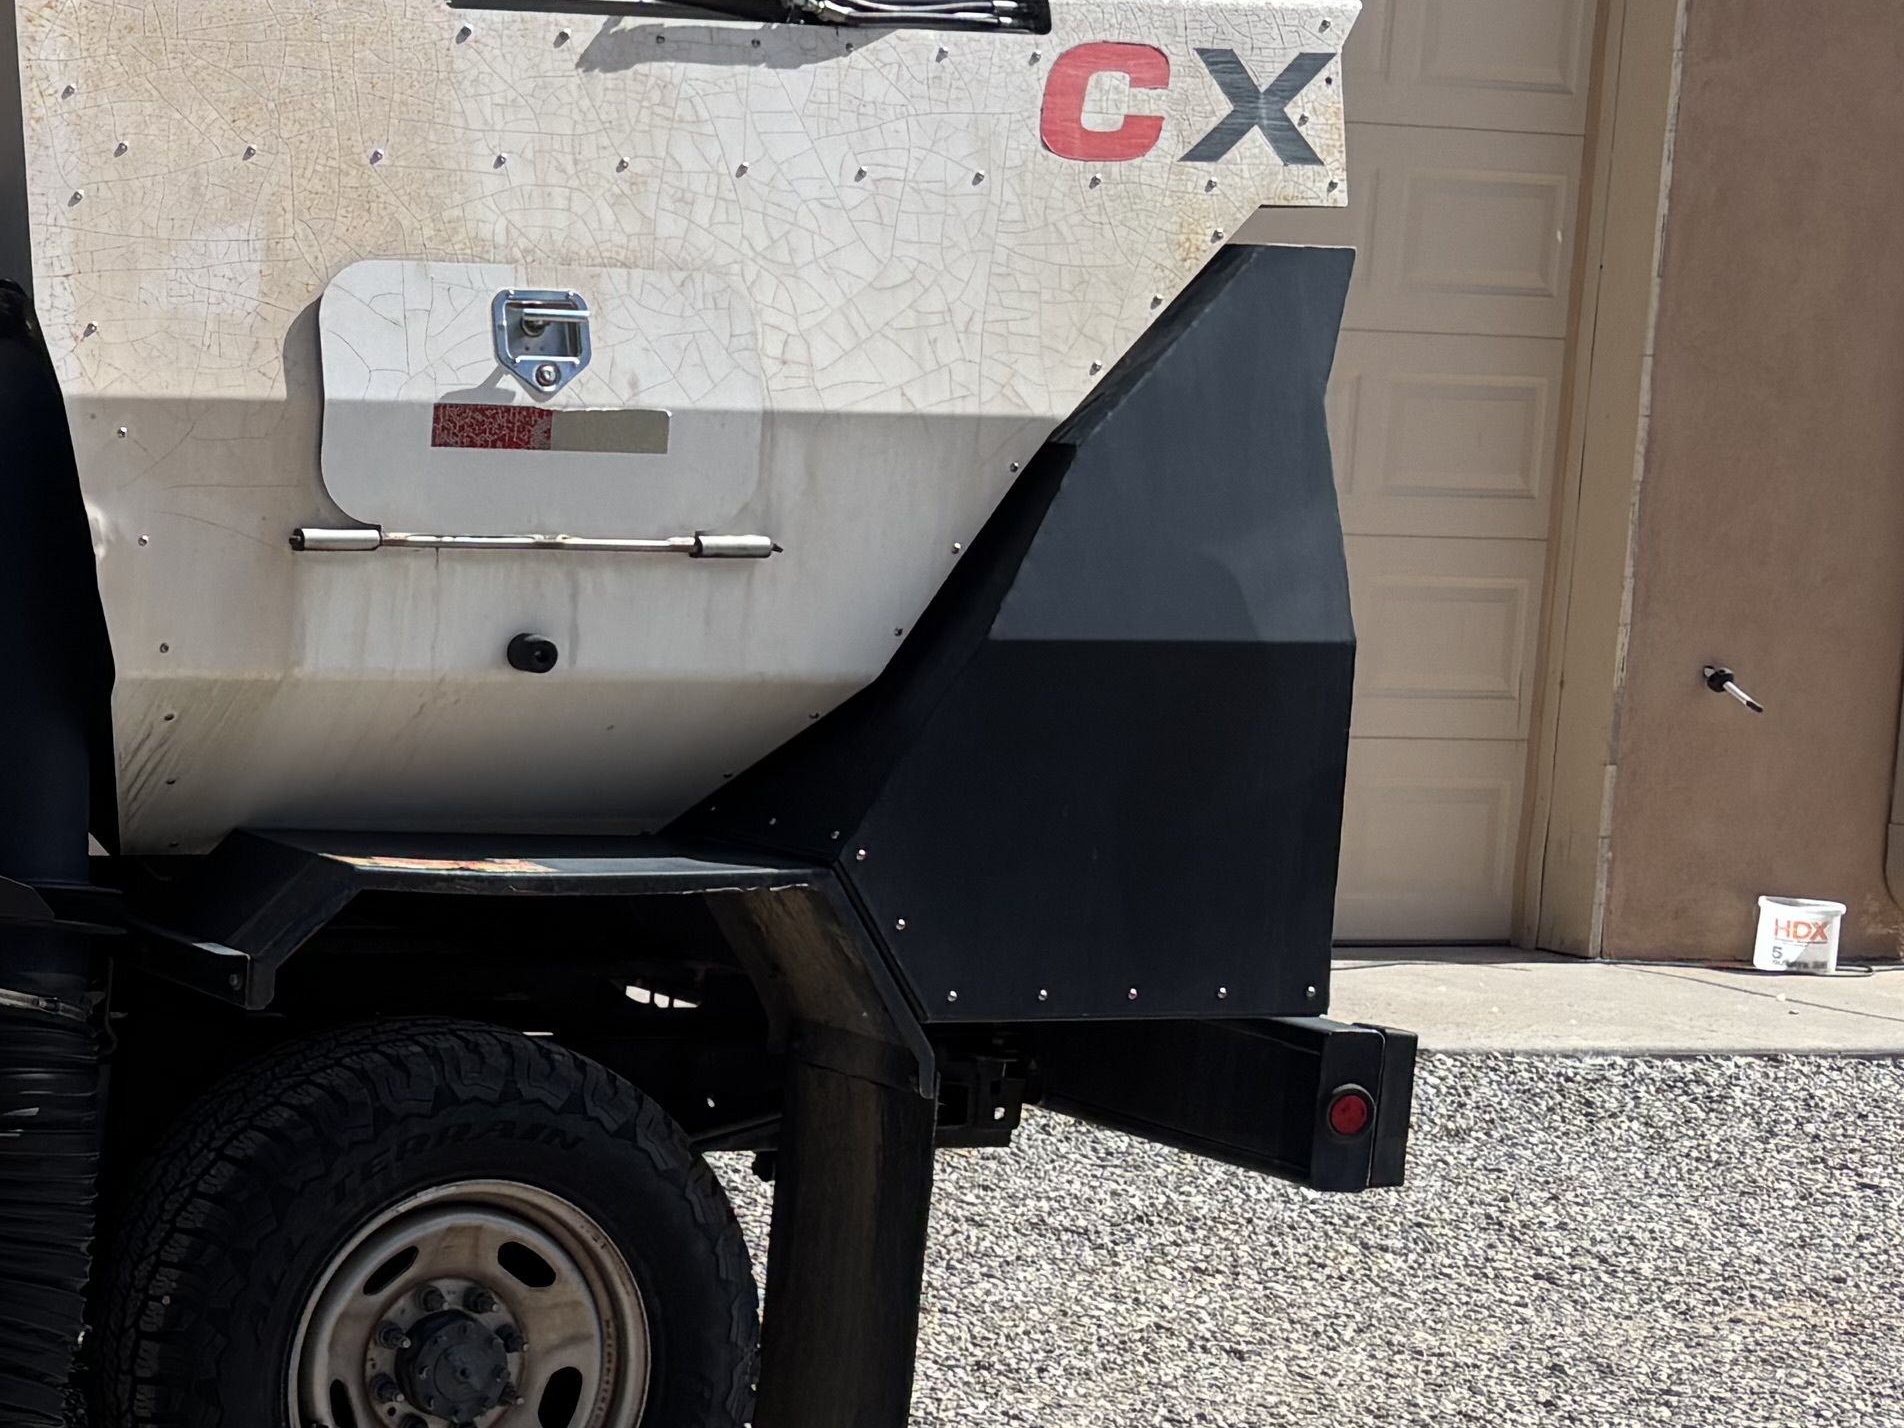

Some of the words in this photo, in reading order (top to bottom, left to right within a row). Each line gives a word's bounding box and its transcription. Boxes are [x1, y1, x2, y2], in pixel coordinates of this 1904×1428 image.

[1039, 40, 1337, 167] CX
[1774, 918, 1830, 941] HDX
[1772, 945, 1783, 959] 5
